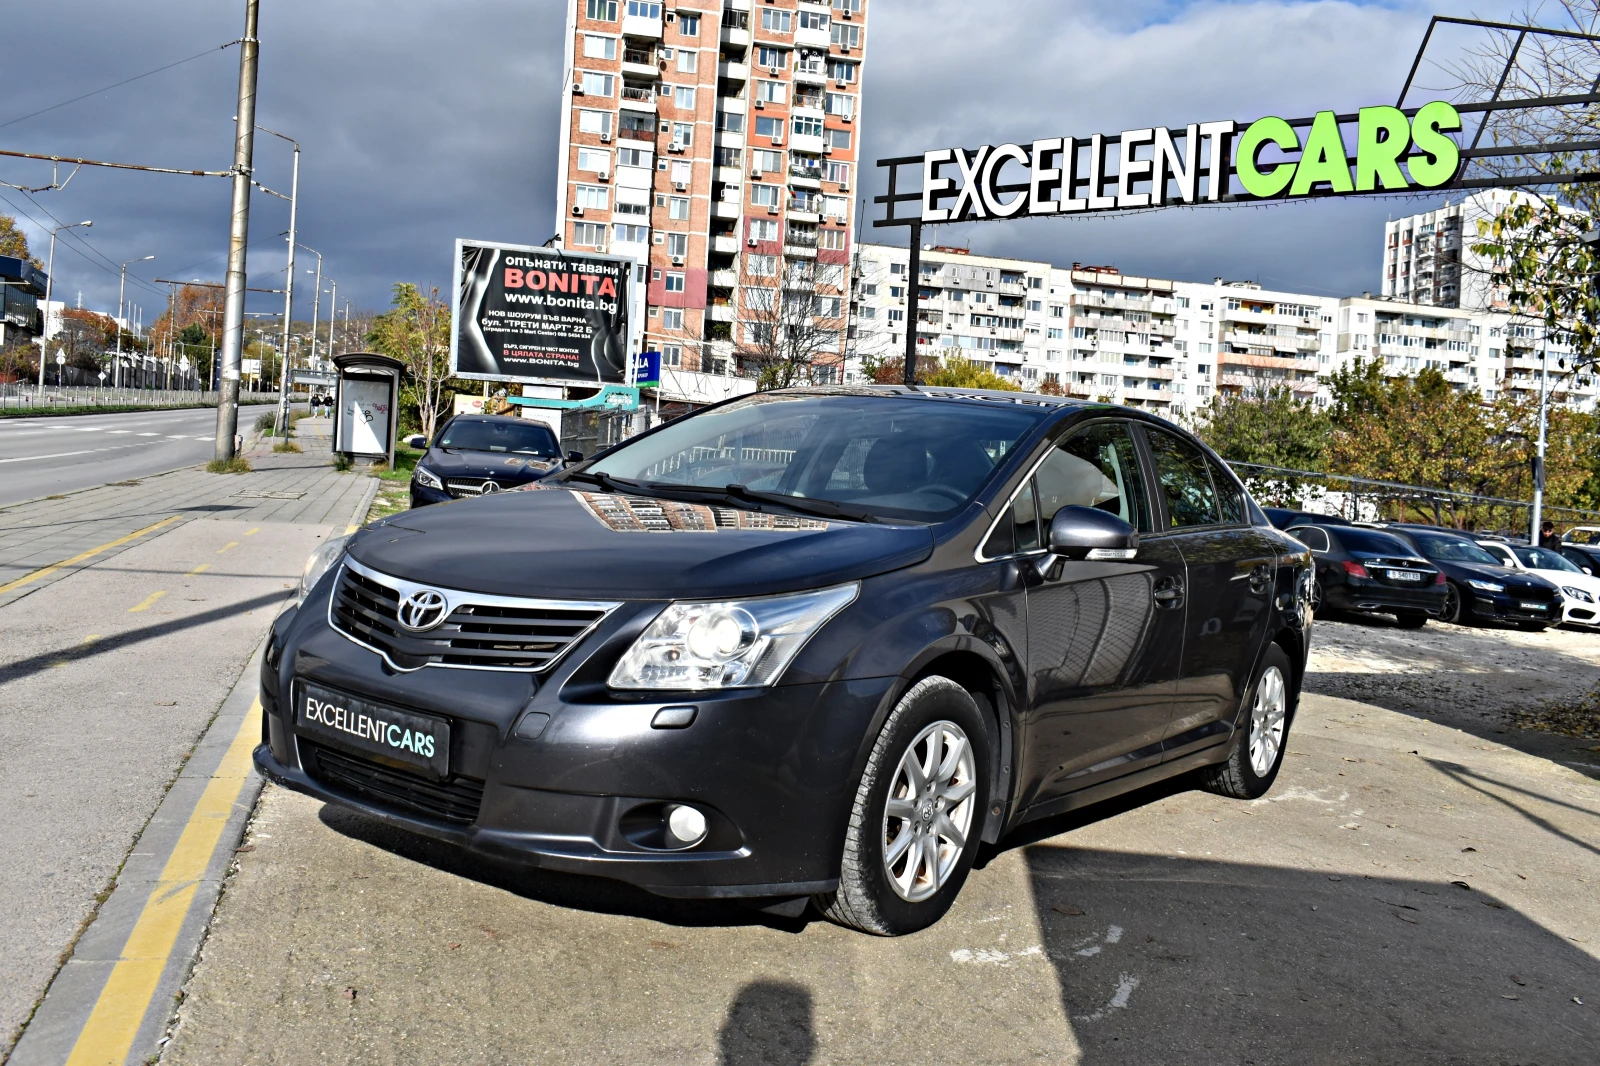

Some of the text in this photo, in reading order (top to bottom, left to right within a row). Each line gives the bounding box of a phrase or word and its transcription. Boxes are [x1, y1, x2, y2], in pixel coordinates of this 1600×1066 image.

[505, 256, 619, 276] опънати тавани
[504, 267, 617, 298] BONITA
[504, 293, 617, 315] www.bonita.bg
[481, 318, 501, 326] бул.
[561, 316, 587, 324] ВАРНА
[511, 350, 544, 358] ЦЯЛАТА
[545, 352, 579, 360] СТРАНА!
[503, 357, 579, 368] www.BONITA.bg
